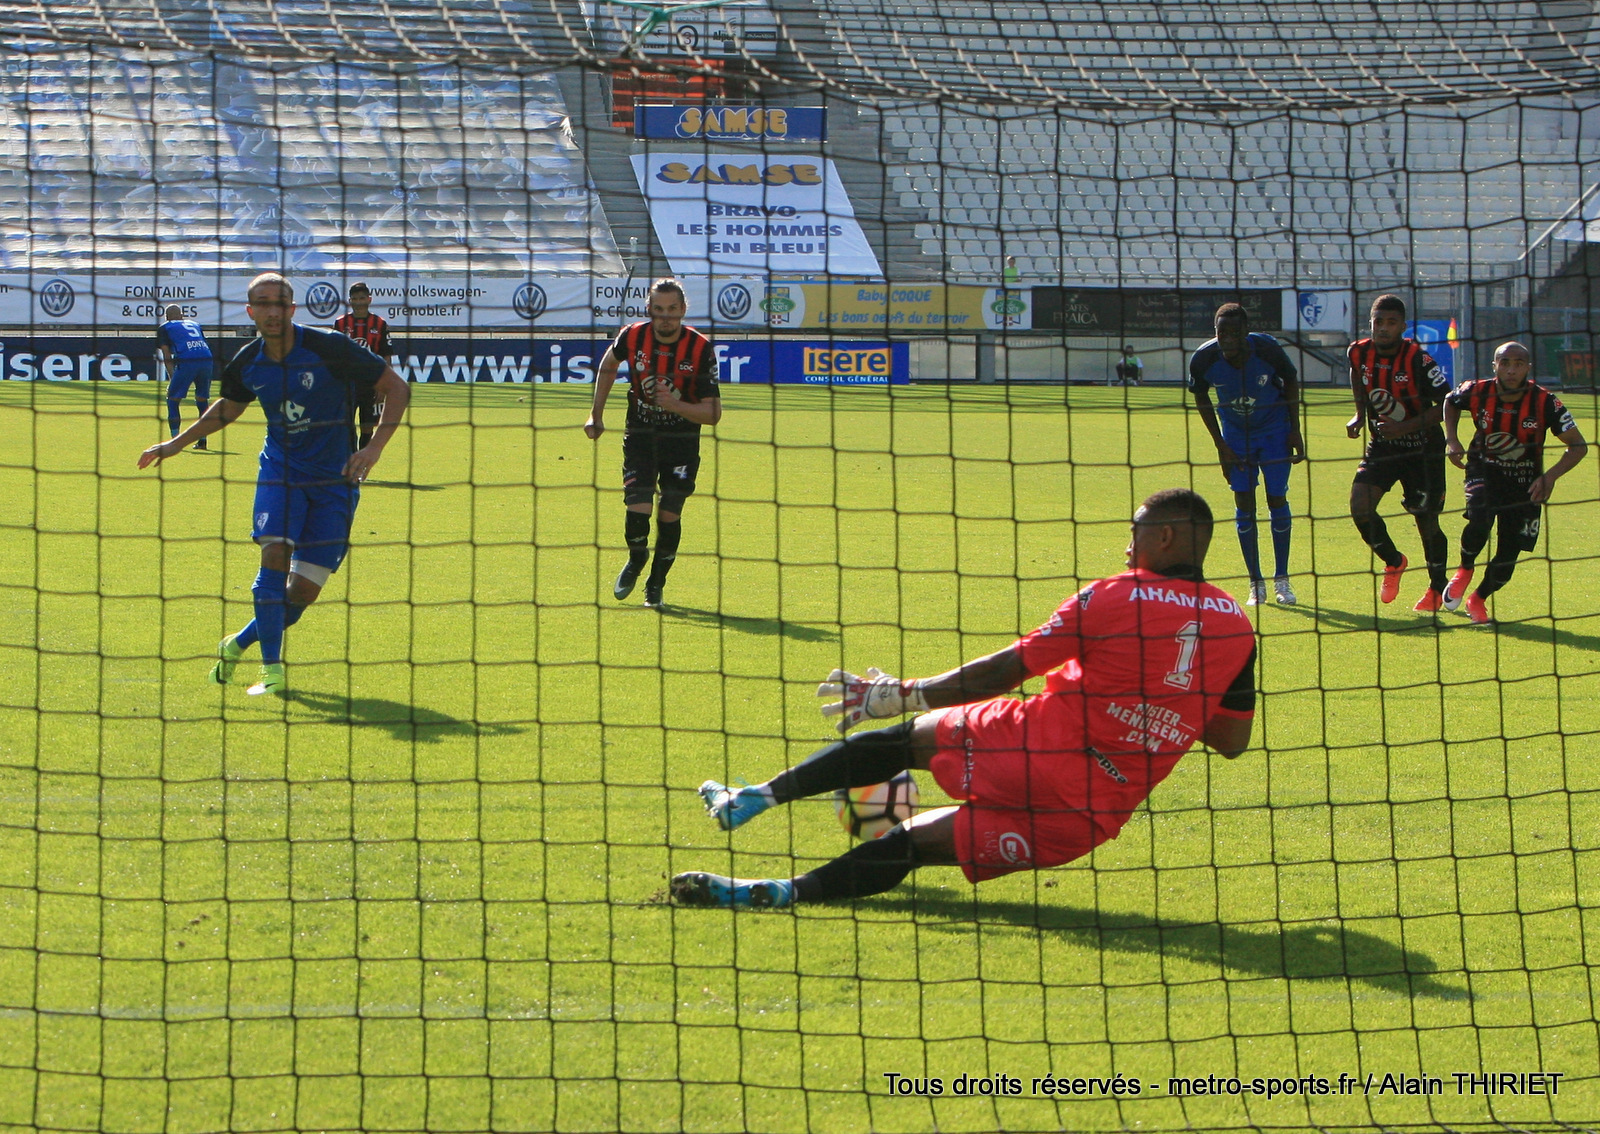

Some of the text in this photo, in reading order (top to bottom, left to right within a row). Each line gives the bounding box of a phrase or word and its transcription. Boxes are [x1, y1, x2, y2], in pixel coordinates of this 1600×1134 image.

[675, 107, 788, 138] SAMSE
[656, 162, 823, 187] SAMSE
[706, 205, 802, 219] BRAVO,
[676, 224, 843, 236] LES HOMMES
[709, 242, 742, 254] EN
[125, 286, 196, 298] FONTAINE
[596, 287, 652, 298] FONTAI
[857, 289, 932, 305] Baby COQUE
[122, 305, 198, 318] & CROES
[388, 304, 462, 319] grenoble.fr
[593, 306, 604, 317] &
[841, 311, 869, 323] bons
[908, 311, 927, 323] du
[182, 322, 200, 338] 5
[673, 464, 688, 480] 4
[1163, 620, 1203, 690] 1
